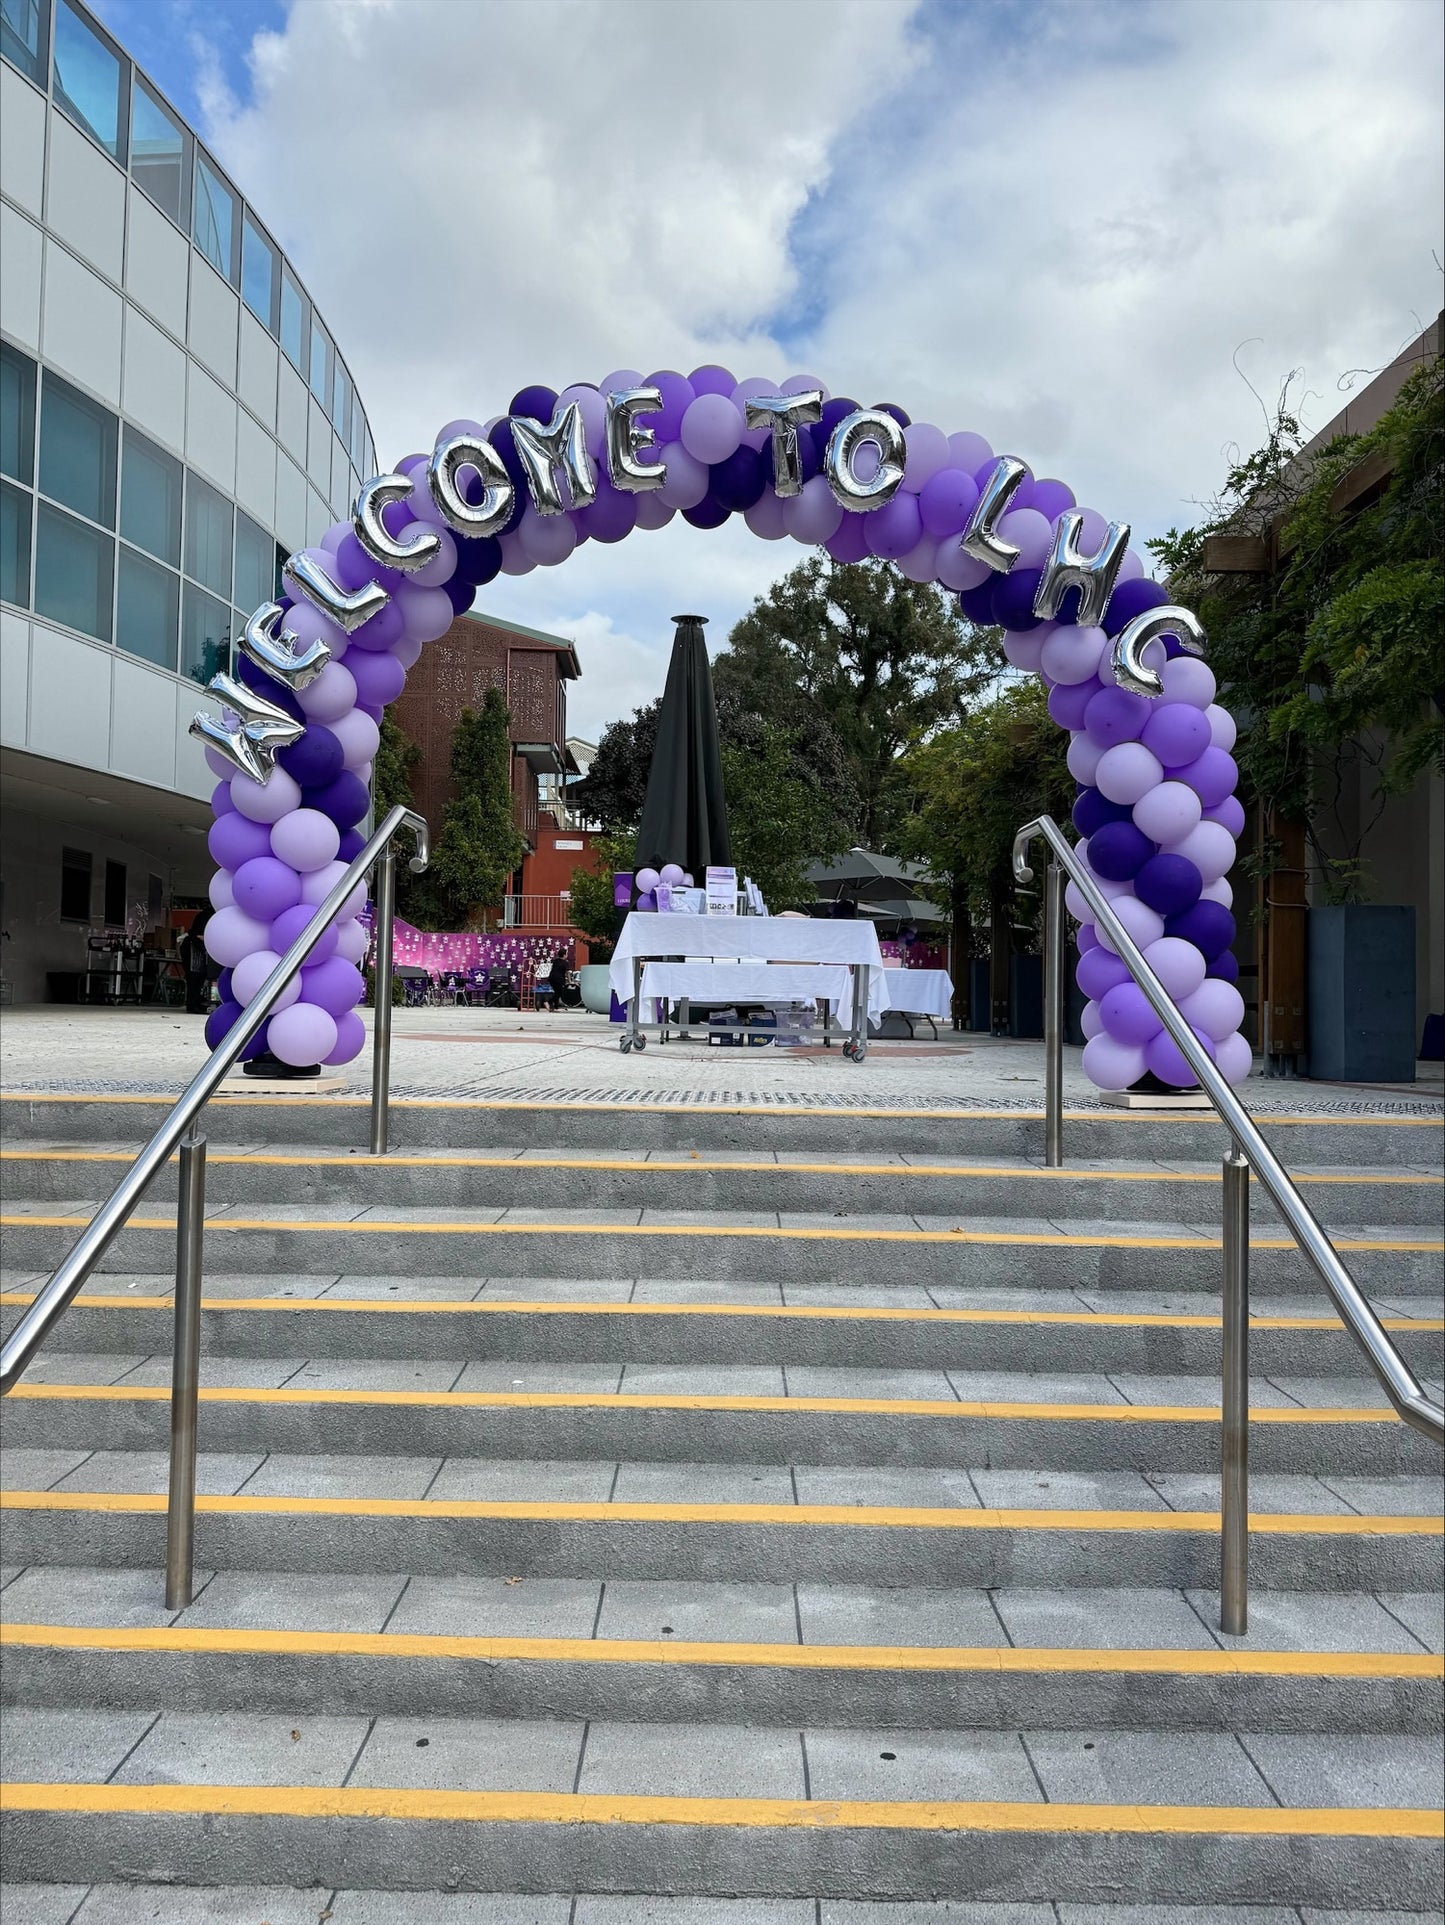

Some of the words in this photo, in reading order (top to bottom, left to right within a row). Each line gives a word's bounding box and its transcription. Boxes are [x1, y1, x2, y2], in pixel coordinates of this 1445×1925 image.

[188, 386, 668, 786] WELCOME
[744, 389, 908, 513] TO
[959, 456, 1209, 699] LHC
